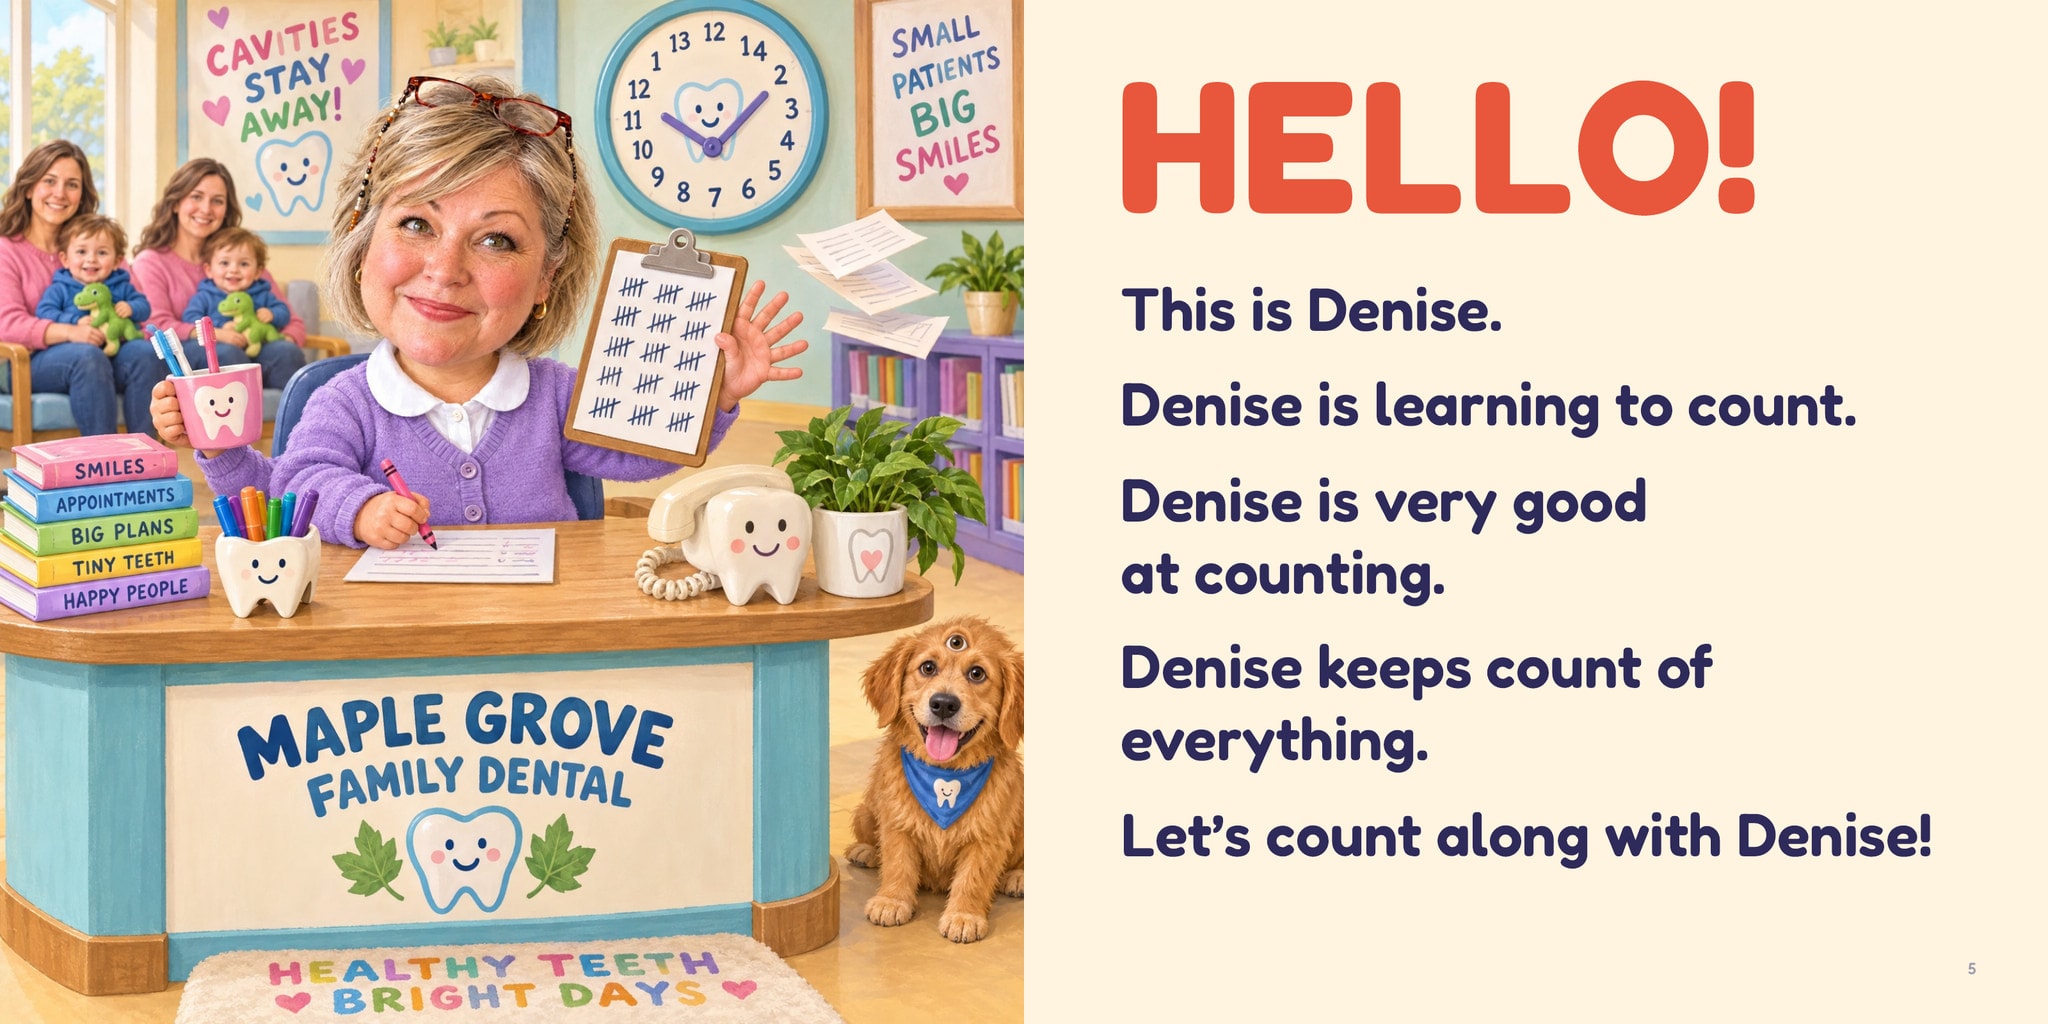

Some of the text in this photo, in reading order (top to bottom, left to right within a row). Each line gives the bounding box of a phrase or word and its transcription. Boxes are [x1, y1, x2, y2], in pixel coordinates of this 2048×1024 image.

[208, 12, 359, 76] CAVITIES
[670, 32, 690, 53] 13
[704, 22, 725, 41] 12
[893, 15, 980, 58] SMALL
[651, 51, 661, 71] 1
[741, 35, 767, 61] 14
[245, 53, 329, 103] STAY
[775, 65, 787, 85] 2
[893, 46, 1000, 99] PATIENTS
[628, 79, 650, 99] 12
[241, 86, 342, 142] AWAY!
[624, 110, 641, 131] 11
[786, 98, 798, 119] 3
[911, 90, 975, 137] BIG
[633, 140, 653, 160] 10
[780, 130, 795, 151] 4
[896, 125, 1000, 181] SMILES
[1122, 80, 1755, 216] HELLO!
[652, 167, 664, 187] 9
[769, 160, 781, 180] 5
[677, 181, 690, 202] 8
[708, 187, 721, 207] 7
[742, 178, 755, 199] 6
[1122, 286, 1501, 332] This is Denise.
[1123, 381, 1856, 438] Denise is learning to count.
[76, 458, 144, 480] SMILES
[58, 488, 174, 513] APPOINTMENTS
[1123, 477, 1646, 535] Denise is very good
[72, 518, 173, 545] BIG PLANS
[72, 551, 174, 576] TINY TEETH
[1122, 549, 1444, 607] at counting.
[64, 578, 188, 610] HAPPY PEOPLE
[1123, 644, 1713, 701] Denise keeps count of
[237, 691, 673, 781] MAPLE GROVE
[1122, 716, 1427, 773] everything.
[307, 756, 631, 818] FAMILY DENTAL
[1124, 812, 1931, 869] Let’s count along with Denise!
[270, 952, 719, 985] HEALTHY TEETH
[1968, 962, 1977, 975] 5
[333, 981, 706, 1015] BRIGHT DAYS
